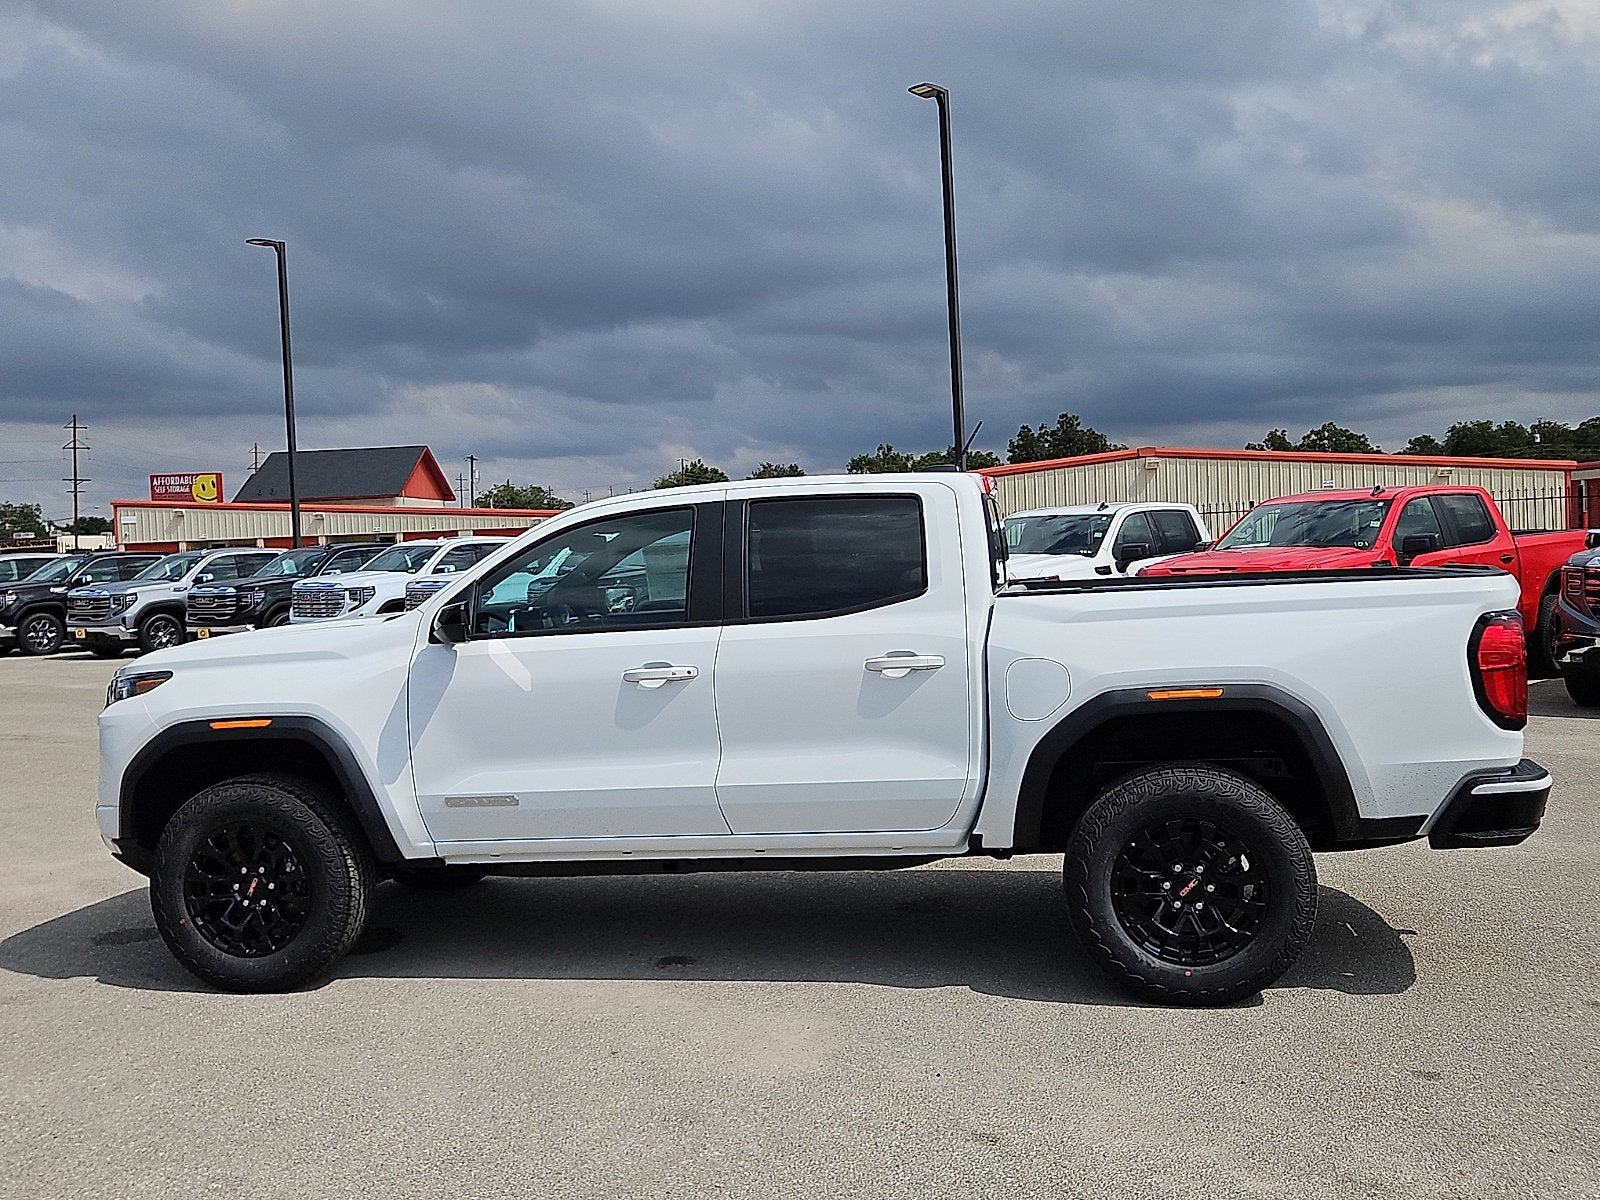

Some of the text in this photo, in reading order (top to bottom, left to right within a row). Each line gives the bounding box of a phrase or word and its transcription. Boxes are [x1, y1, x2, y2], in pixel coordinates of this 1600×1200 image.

[153, 475, 197, 486] AFFORDABLE
[154, 485, 190, 493] SELF STORAGE
[1179, 878, 1199, 897] GMC
